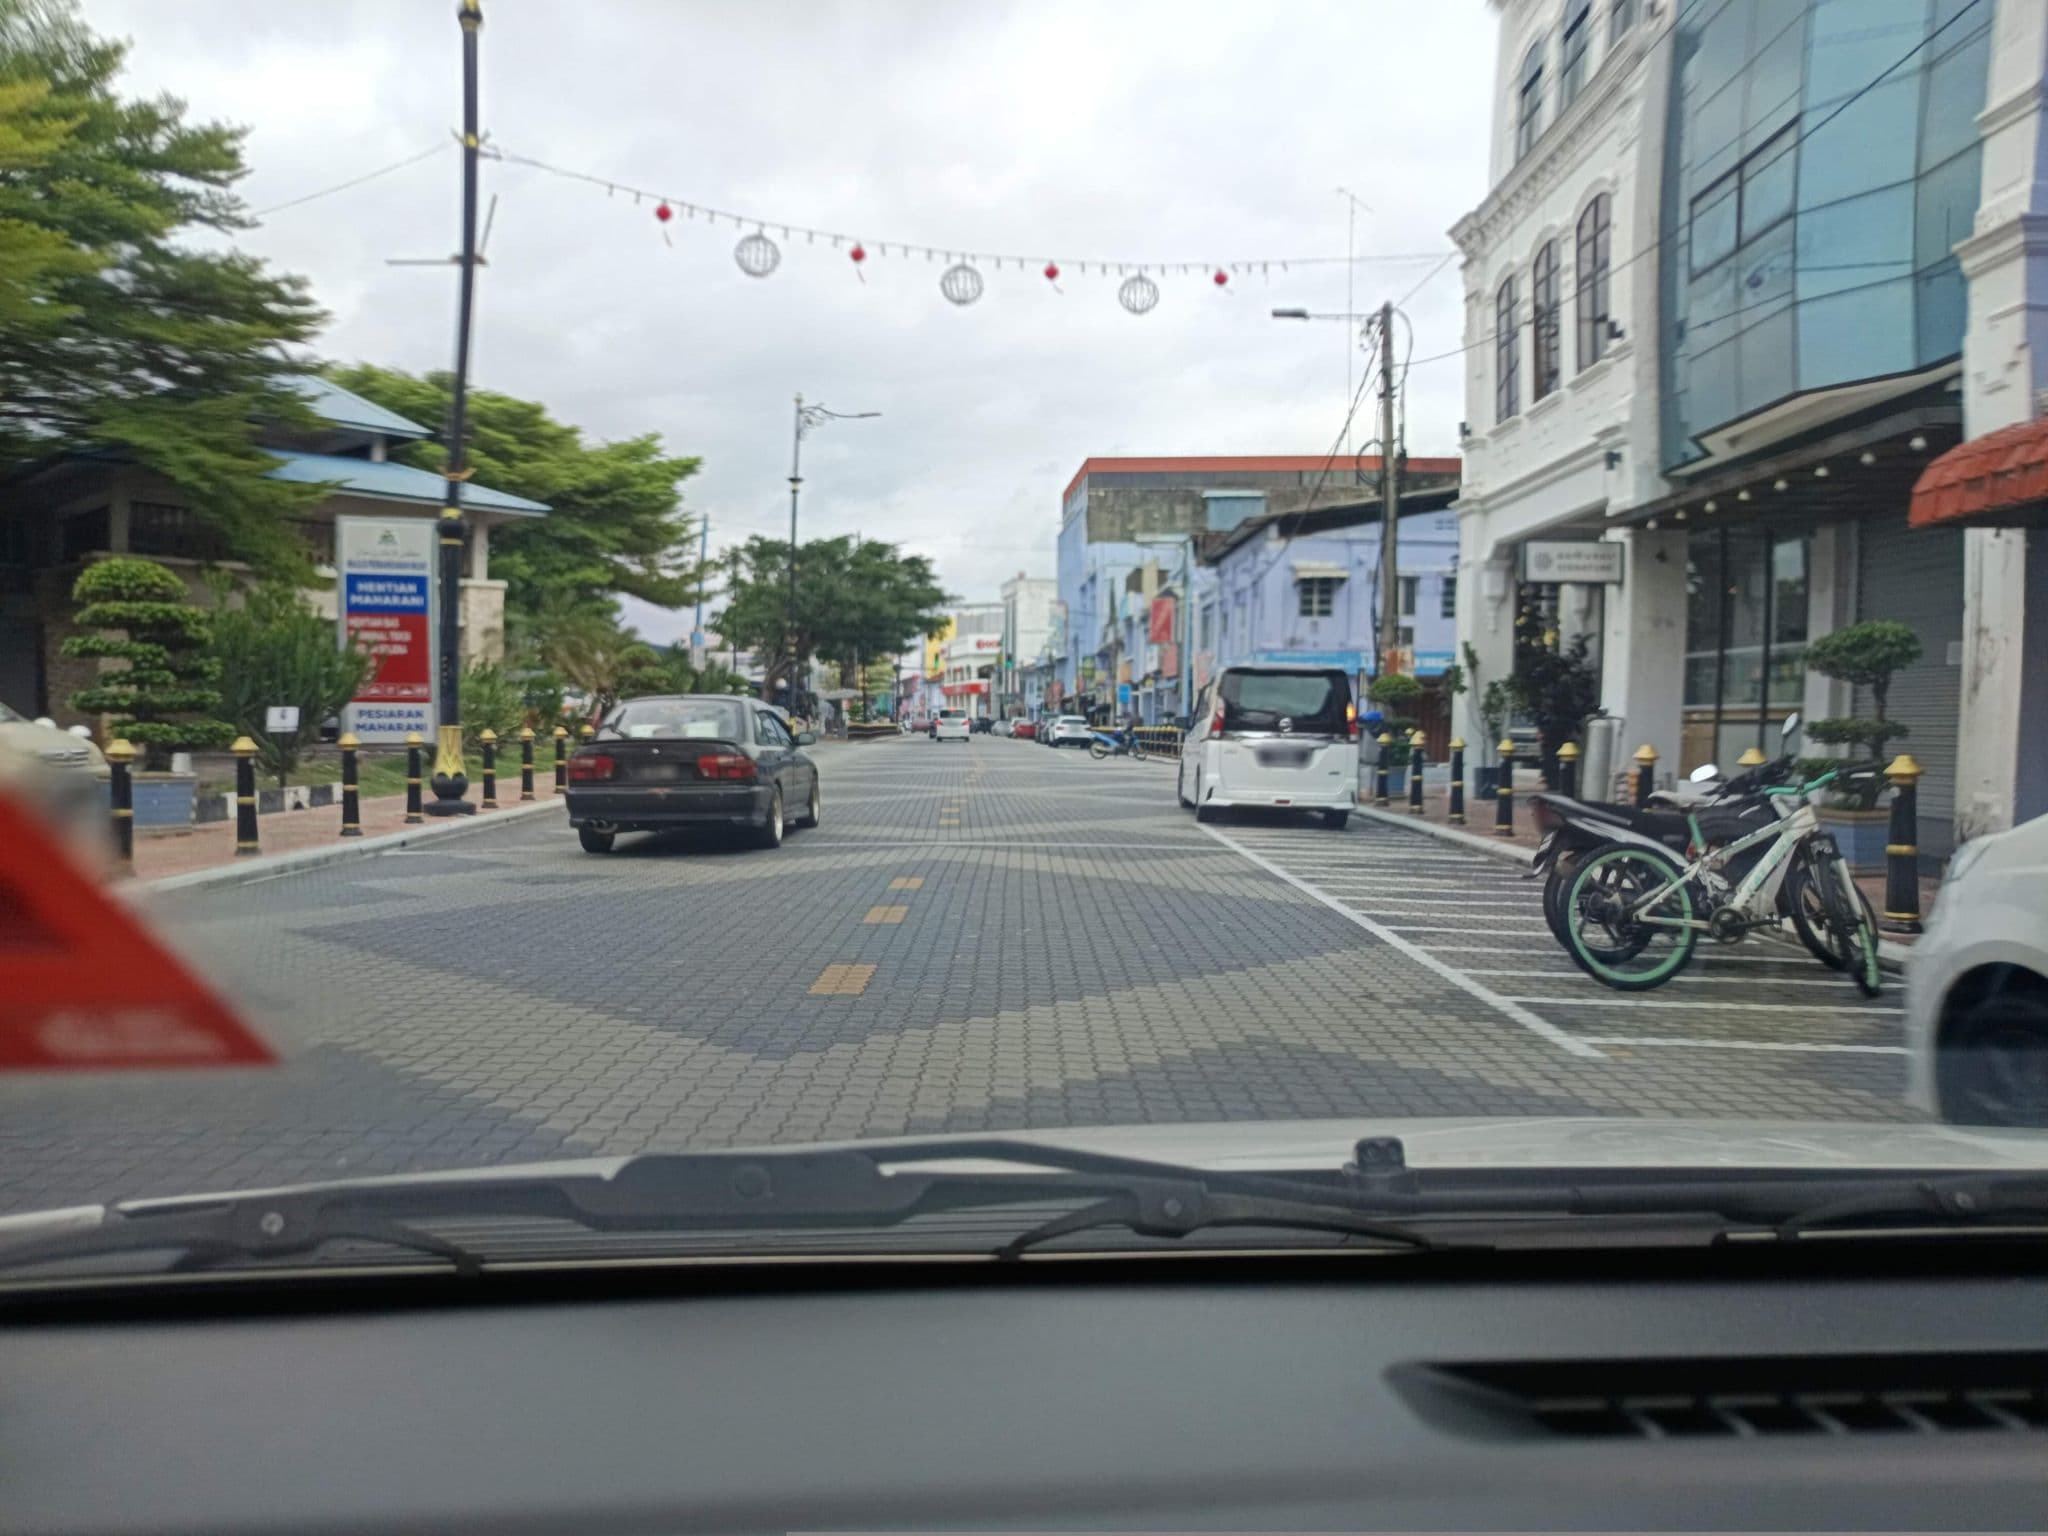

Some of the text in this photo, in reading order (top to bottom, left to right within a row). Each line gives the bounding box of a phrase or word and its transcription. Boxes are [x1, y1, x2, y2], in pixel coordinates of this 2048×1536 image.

[356, 582, 417, 593] HENTIAN
[350, 594, 425, 606] MAHARANI
[358, 709, 424, 719] PESIARAN
[356, 722, 428, 732] MAHARANI
